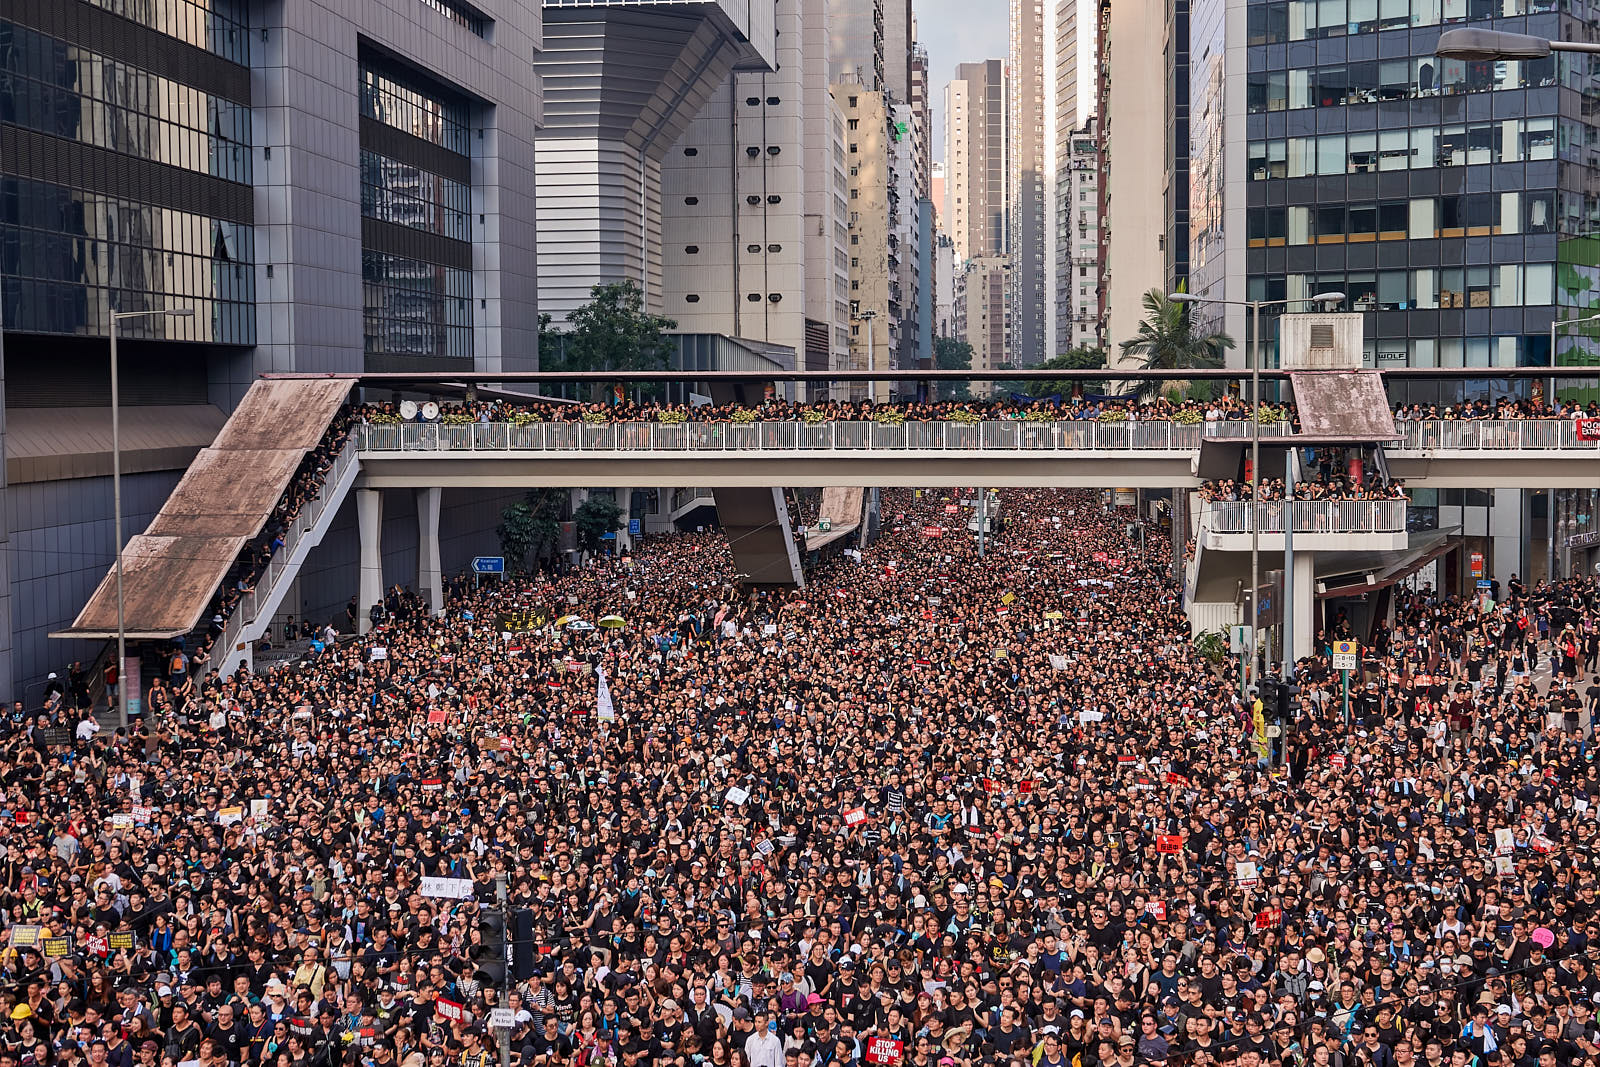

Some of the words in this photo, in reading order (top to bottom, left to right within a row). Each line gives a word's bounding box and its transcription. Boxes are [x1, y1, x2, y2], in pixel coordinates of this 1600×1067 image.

[1581, 420, 1592, 429] NO
[875, 1039, 896, 1049] STOP
[869, 1045, 899, 1058] KILLING
[877, 1054, 889, 1063] US
